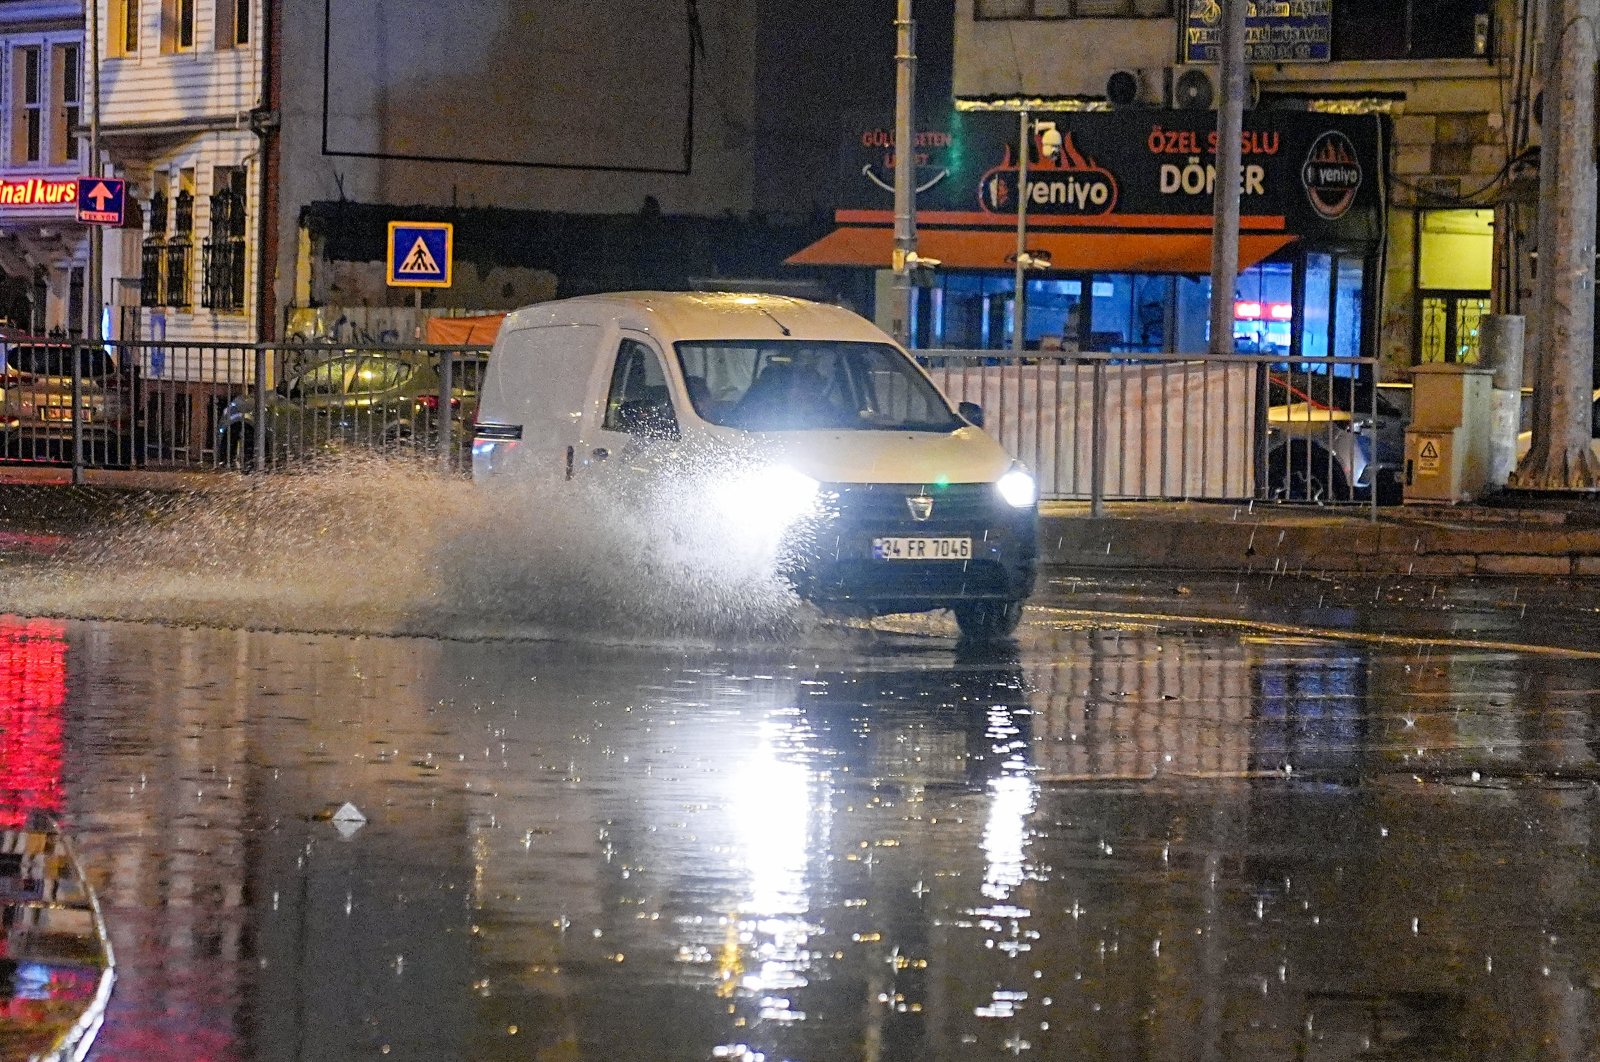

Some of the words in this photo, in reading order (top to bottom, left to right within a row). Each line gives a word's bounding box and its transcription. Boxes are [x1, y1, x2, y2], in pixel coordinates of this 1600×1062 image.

[1147, 123, 1201, 154] ÖZEL
[1206, 130, 1280, 154] SSLU
[1320, 166, 1358, 185] yeniyo
[882, 540, 900, 557] 34
[908, 540, 925, 557] FR
[932, 540, 969, 557] 7046
